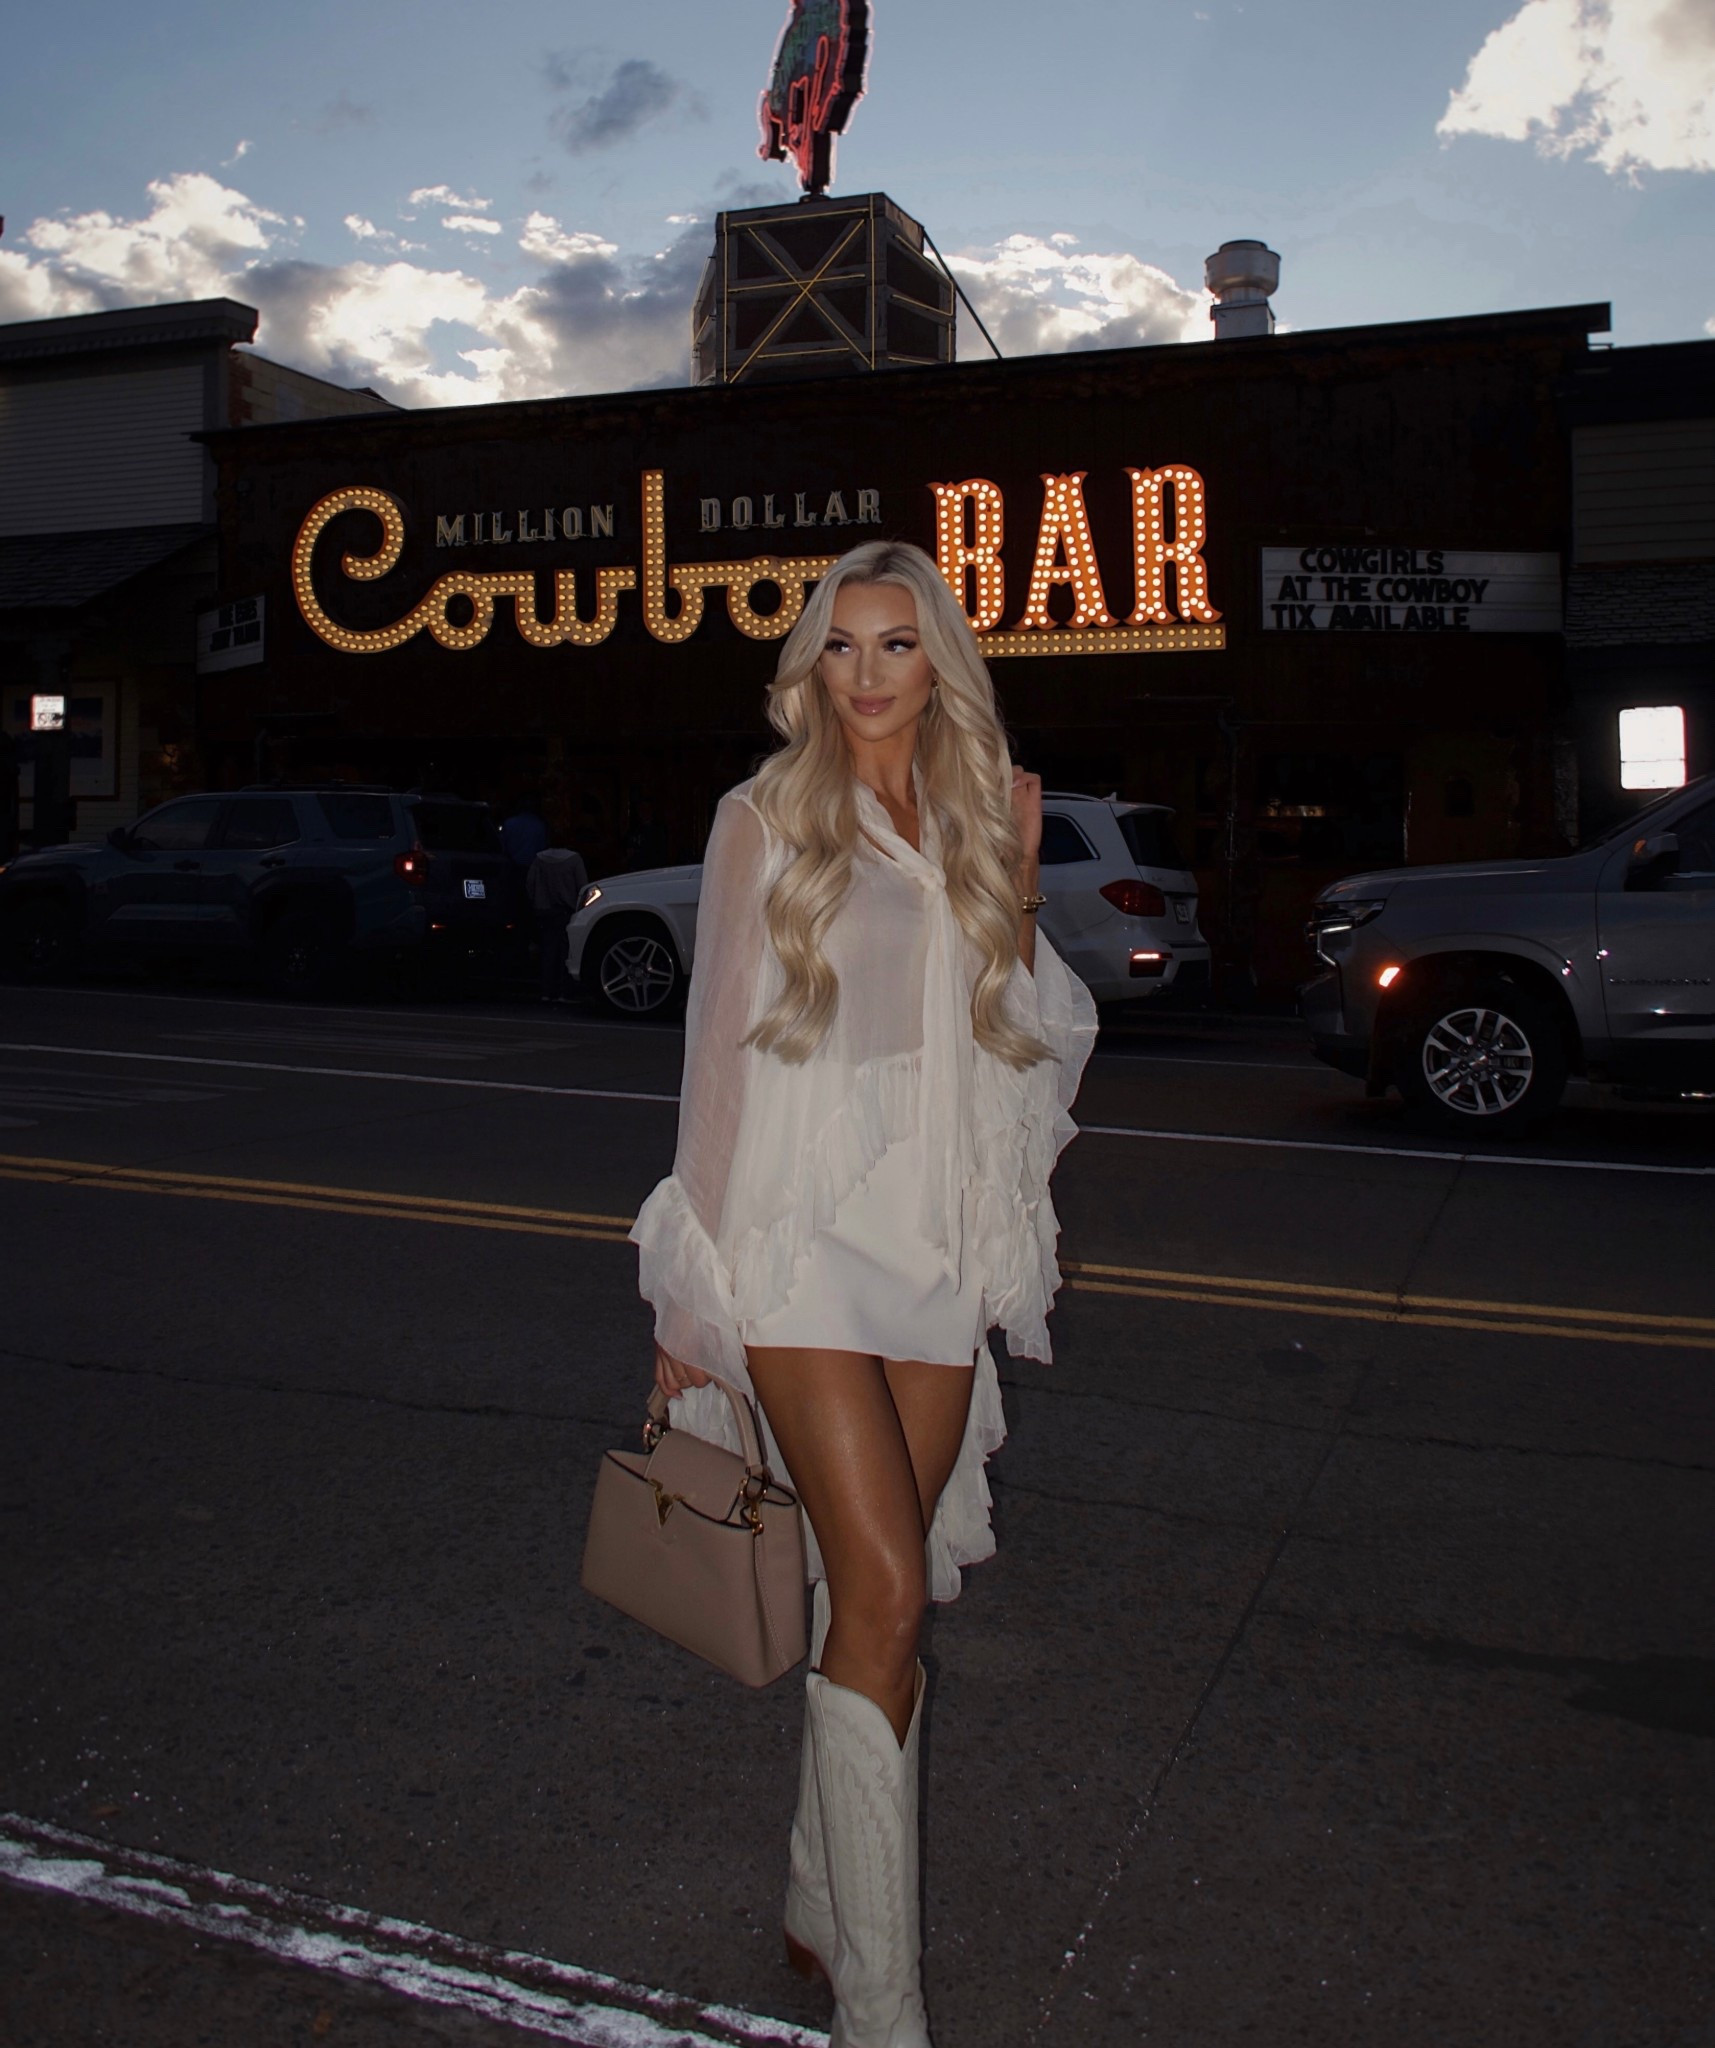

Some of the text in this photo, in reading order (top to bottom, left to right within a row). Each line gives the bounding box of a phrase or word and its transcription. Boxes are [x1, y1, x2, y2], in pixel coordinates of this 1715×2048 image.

[436, 489, 883, 547] MILLION DOLLAR
[292, 464, 1223, 652] Cowbo BAR
[1301, 549, 1444, 574] COWGIRLS
[1278, 576, 1489, 603] AT THE COWBOY
[1271, 604, 1316, 630] TIX
